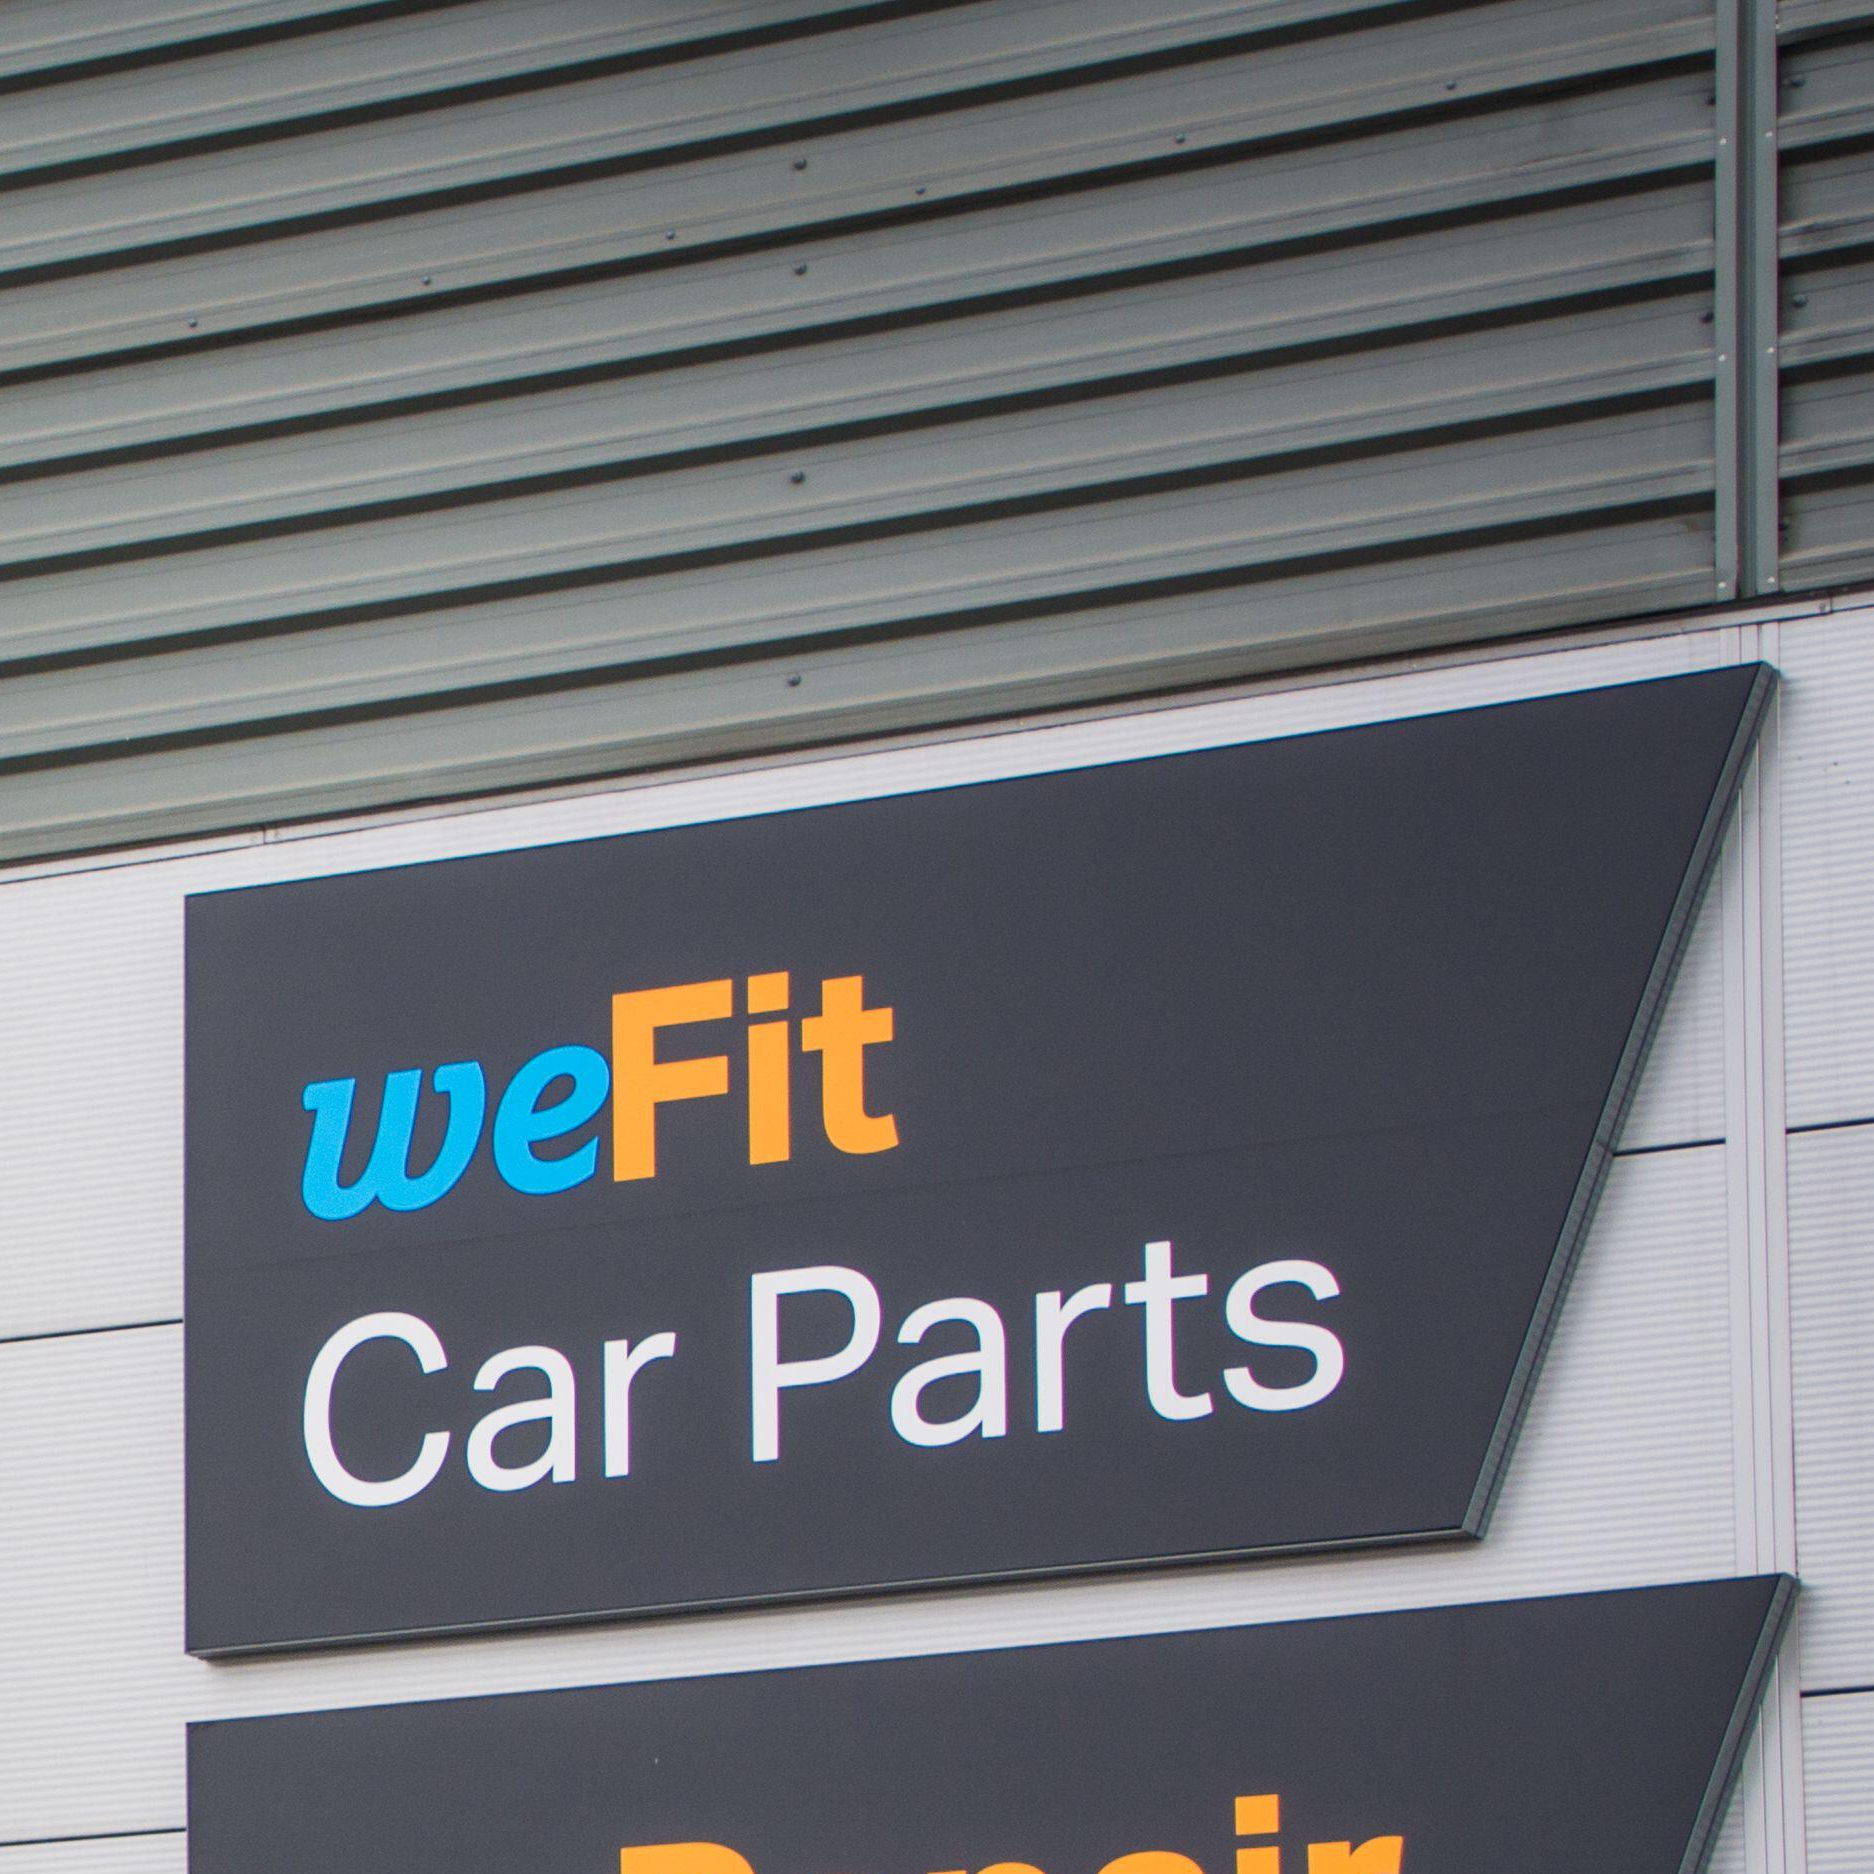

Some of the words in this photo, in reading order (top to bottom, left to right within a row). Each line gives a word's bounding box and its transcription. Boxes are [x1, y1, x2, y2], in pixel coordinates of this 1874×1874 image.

[301, 971, 899, 1221] weFit
[303, 1311, 676, 1507] Car
[751, 1241, 1345, 1462] Parts
